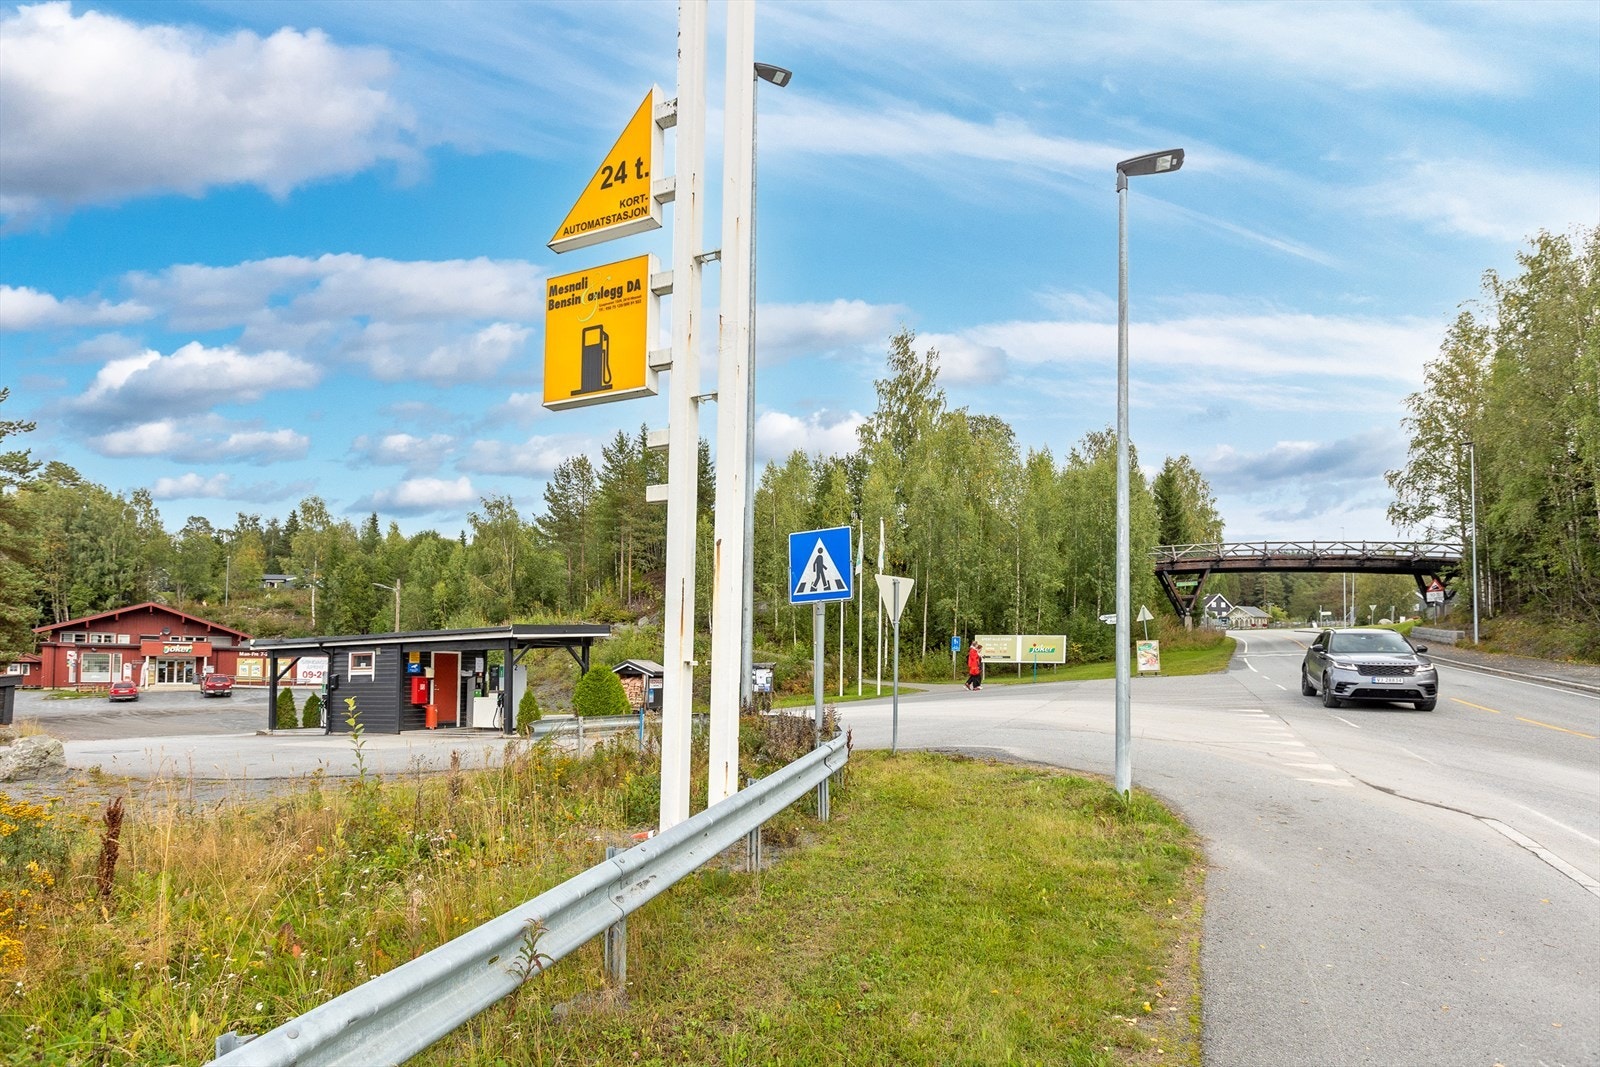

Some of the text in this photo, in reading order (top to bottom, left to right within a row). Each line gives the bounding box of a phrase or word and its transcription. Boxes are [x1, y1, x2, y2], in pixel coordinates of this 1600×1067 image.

[600, 156, 649, 190] 24 t.
[619, 193, 649, 209] KORT-
[562, 206, 648, 236] AUTOMATSTASJON
[548, 293, 581, 311] Bensin
[627, 279, 641, 293] DA
[549, 277, 588, 297] Mesnali
[163, 644, 193, 654] joker
[1031, 643, 1054, 654] joker
